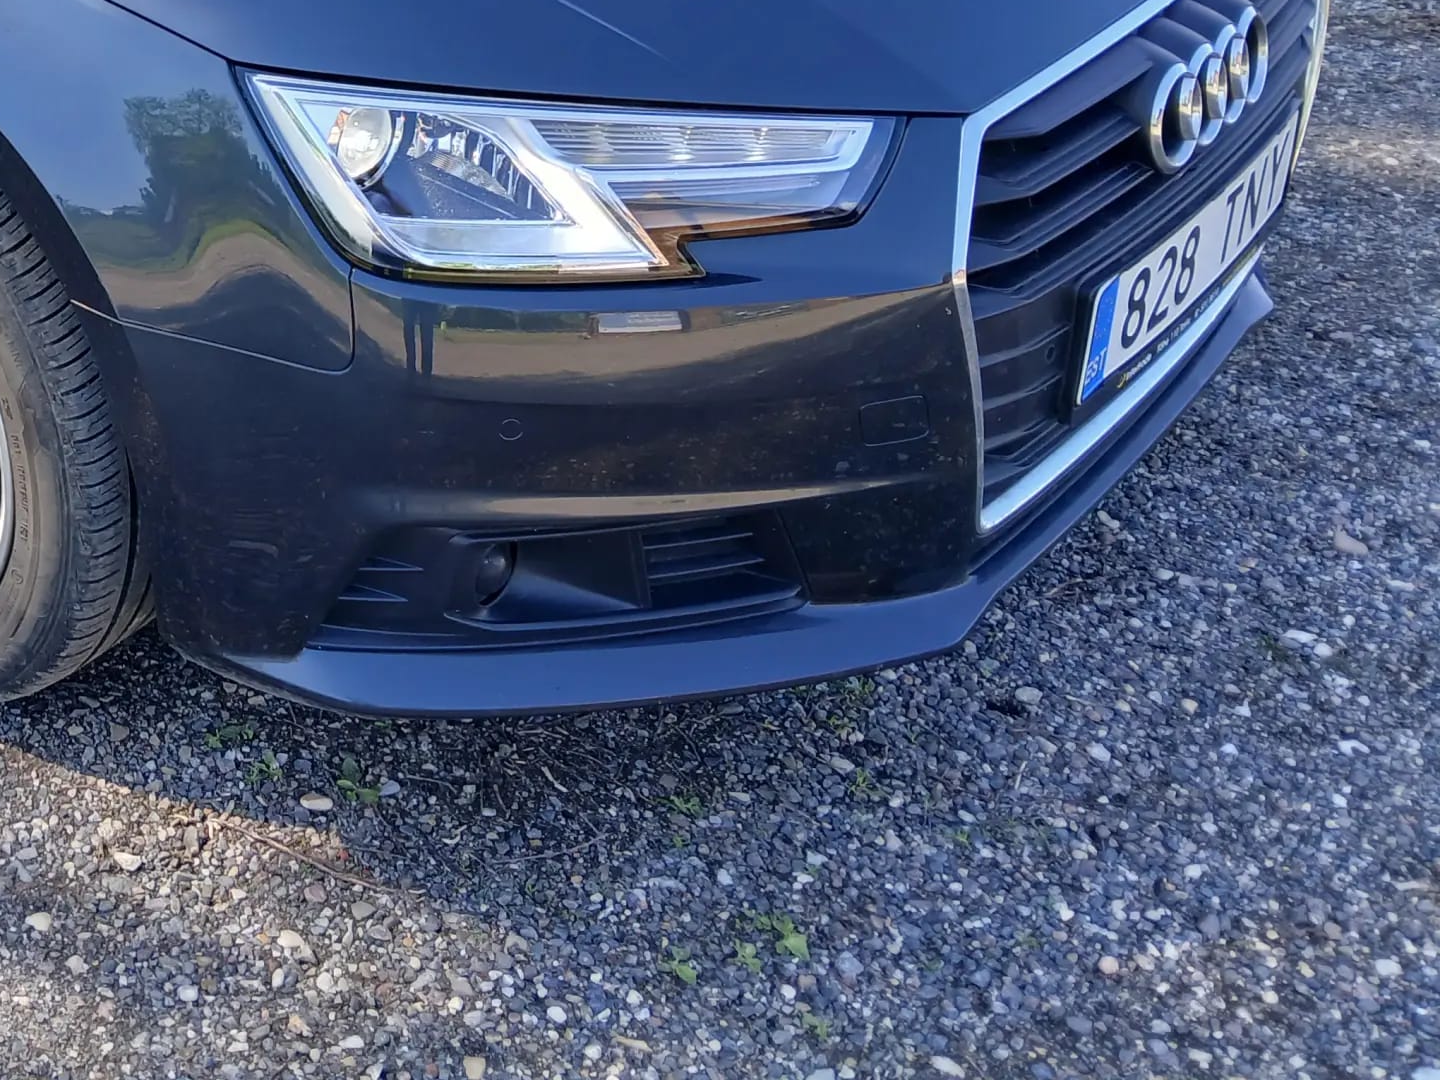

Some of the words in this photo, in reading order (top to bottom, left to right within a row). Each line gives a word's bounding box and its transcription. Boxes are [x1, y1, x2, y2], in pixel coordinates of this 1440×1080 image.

[1121, 224, 1201, 349] 828
[1221, 130, 1291, 265] TNY
[1084, 347, 1107, 386] EST
